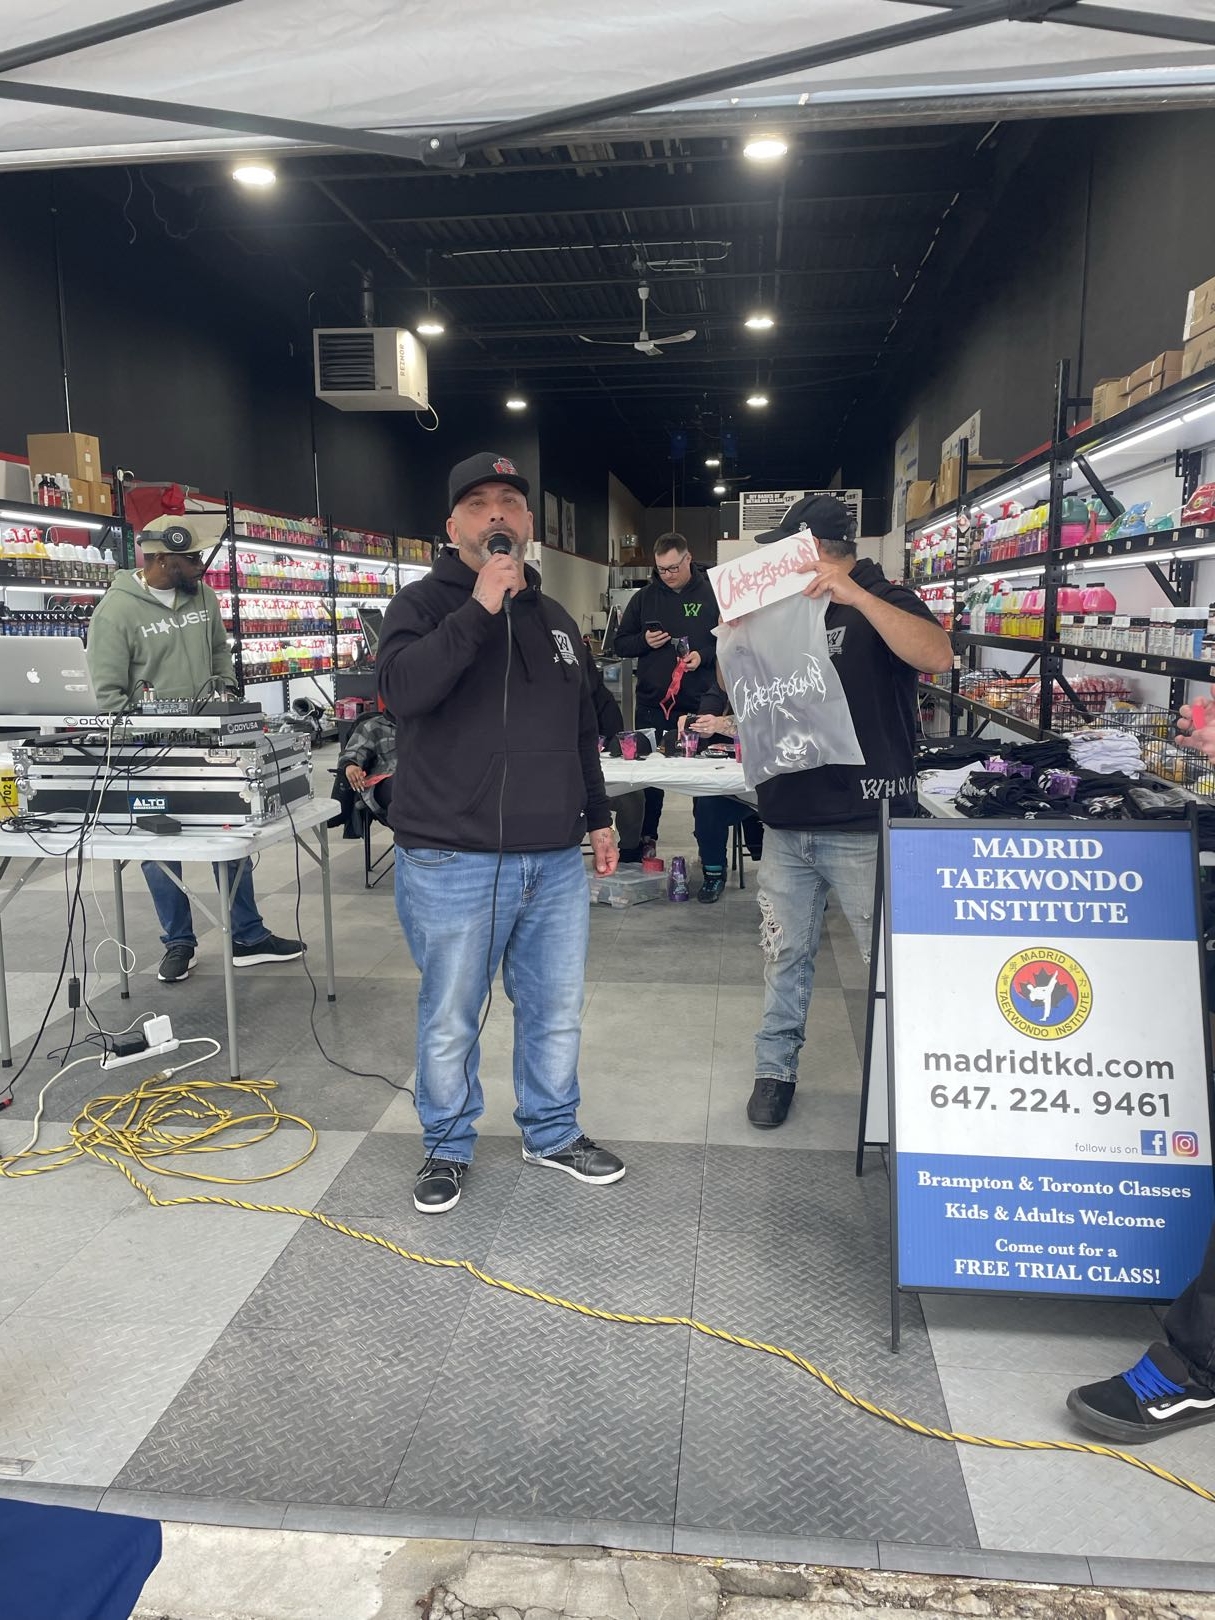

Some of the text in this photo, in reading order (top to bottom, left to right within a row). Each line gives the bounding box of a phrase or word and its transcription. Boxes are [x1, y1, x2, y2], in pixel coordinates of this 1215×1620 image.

[141, 610, 210, 637] HUSE
[133, 797, 165, 807] ALTO
[972, 837, 1103, 859] MADRID
[936, 868, 1143, 892] TAEKWONDO
[954, 899, 1129, 923] INSTITUTE
[1020, 950, 1066, 964] MADRID
[999, 990, 1090, 1038] TAEKWONDO INSTITUTE
[924, 1049, 1175, 1079] madridtkd.com
[930, 1084, 1170, 1117] 647. 224. 9461
[1075, 1142, 1107, 1153] follow
[1110, 1145, 1122, 1154] us
[1124, 1146, 1138, 1154] on
[917, 1171, 1191, 1198] Brampton & Toronto Classes
[945, 1203, 1166, 1228] Kids & Adults Welcome
[995, 1239, 1118, 1258] Come out for a
[954, 1258, 1161, 1284] FREE TRIAL CLASS!
